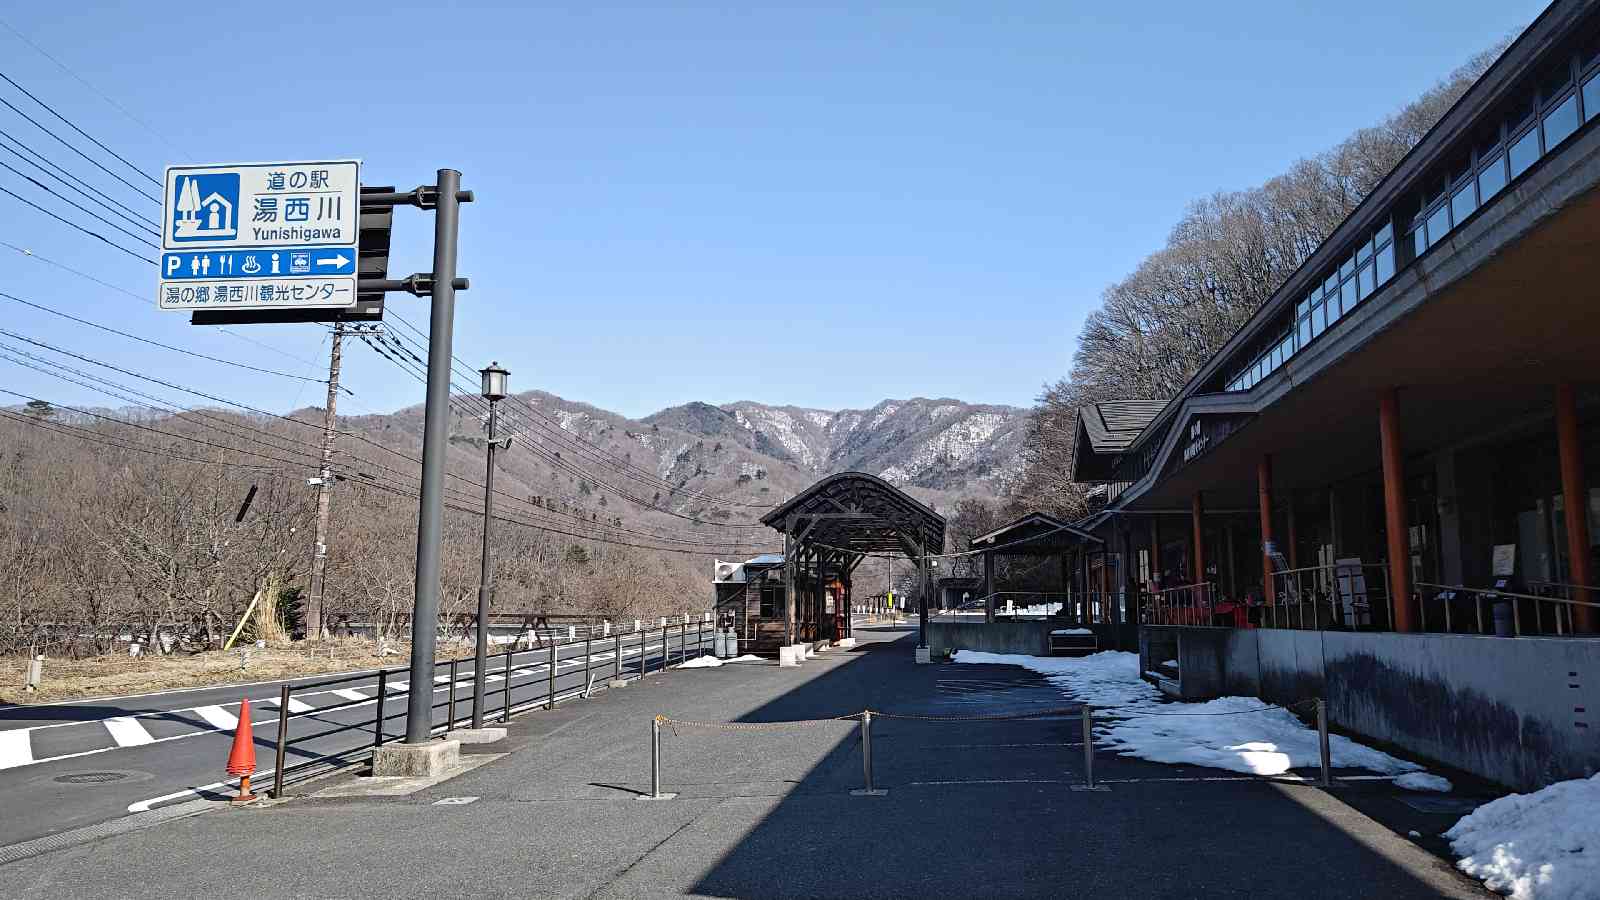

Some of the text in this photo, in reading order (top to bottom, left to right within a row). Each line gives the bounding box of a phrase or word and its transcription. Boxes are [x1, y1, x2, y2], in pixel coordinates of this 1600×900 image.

[266, 170, 329, 191] 道の駅
[252, 196, 341, 223] 湯西川
[252, 226, 341, 241] Yunishigawa
[165, 283, 349, 304] 湯の郷 湯西川観光センター
